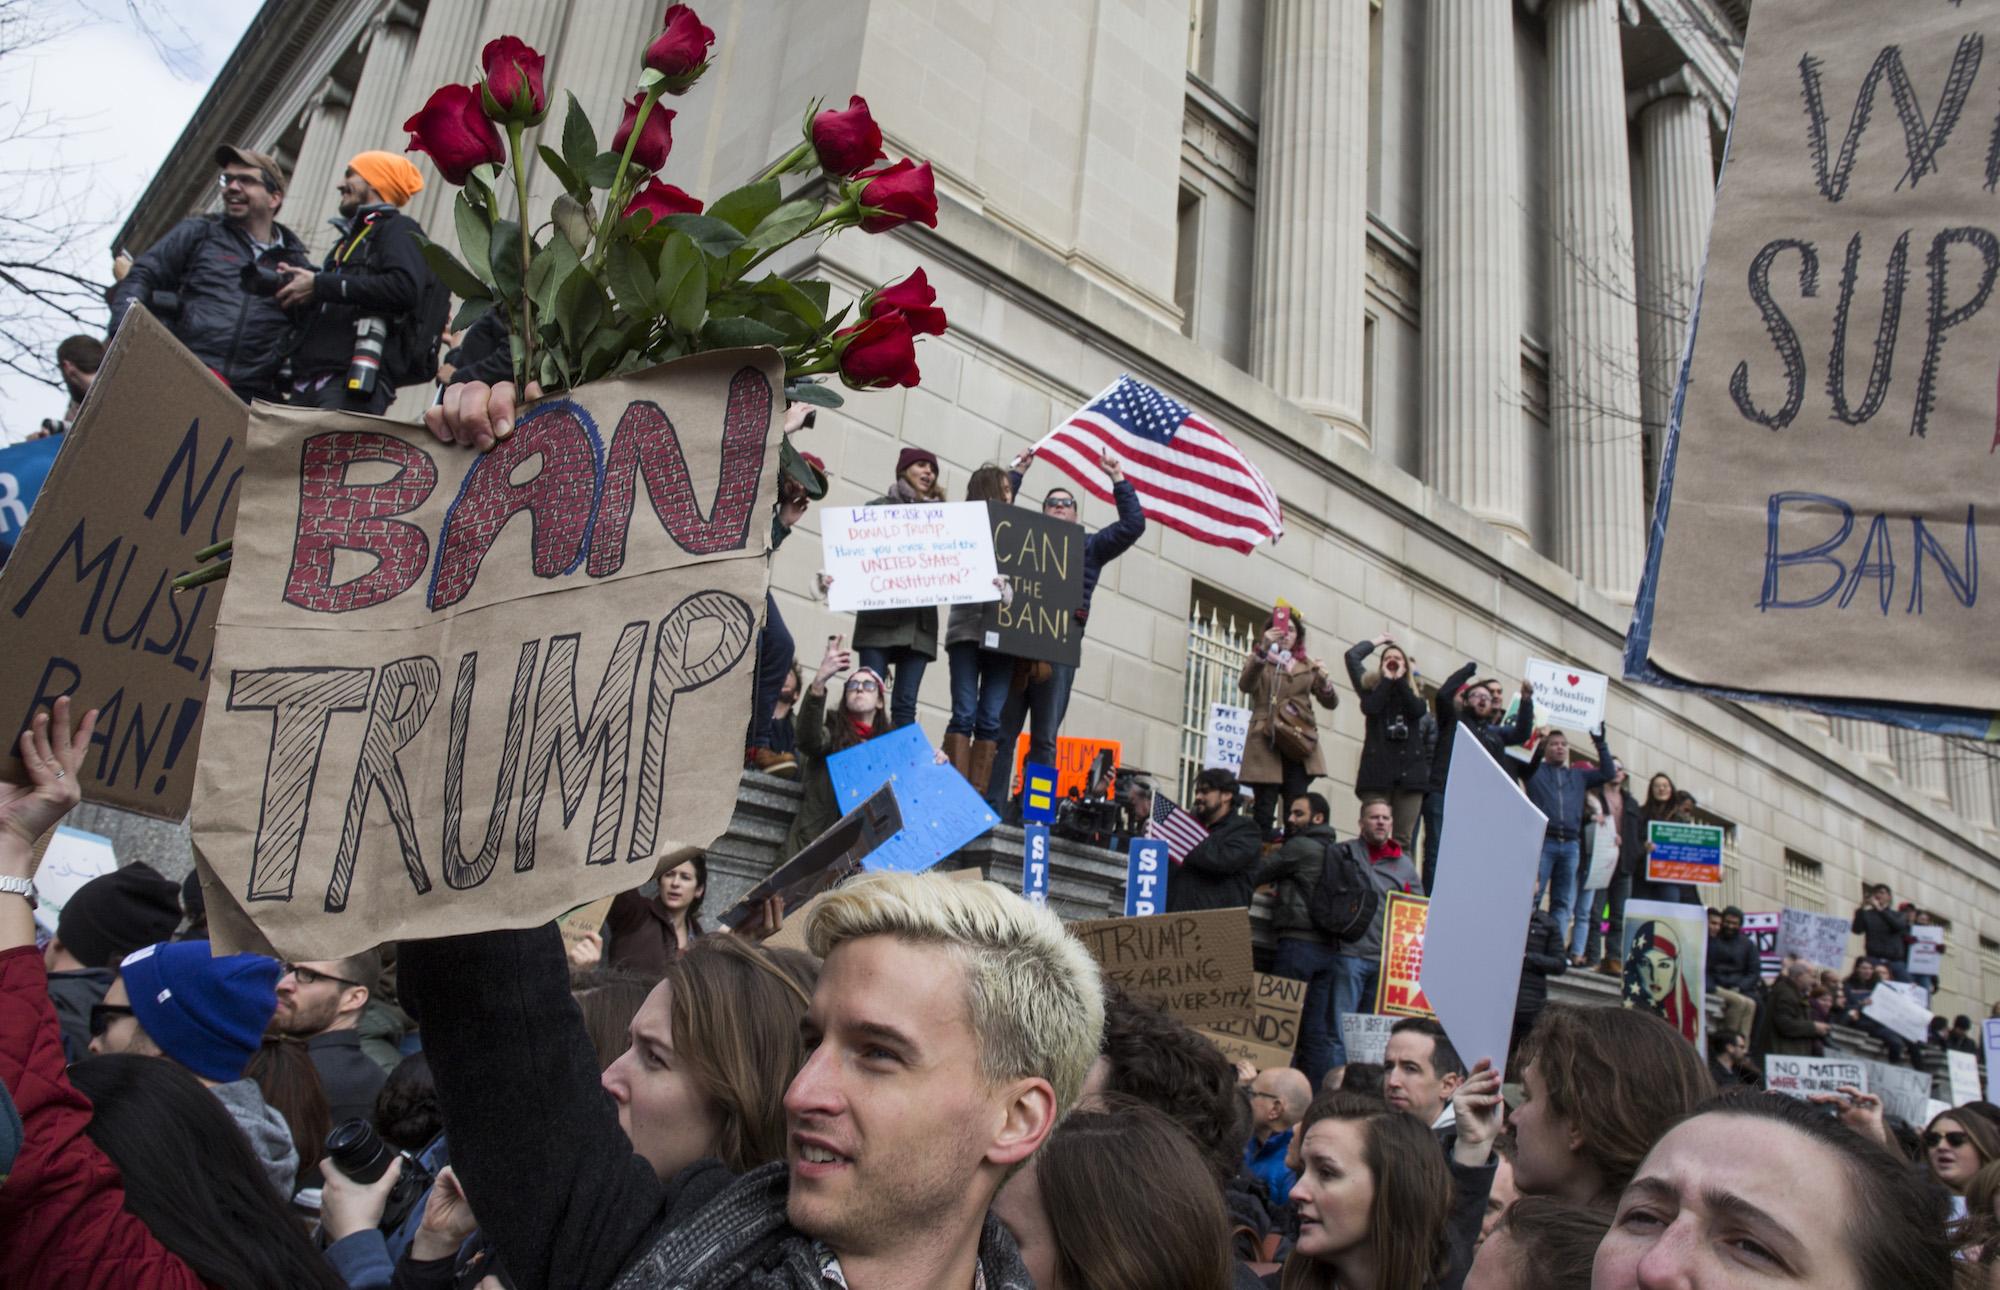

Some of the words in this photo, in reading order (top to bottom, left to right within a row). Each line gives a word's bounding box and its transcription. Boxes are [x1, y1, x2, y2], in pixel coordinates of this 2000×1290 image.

[1798, 31, 2000, 203] W
[281, 366, 774, 613] BAN
[993, 520, 1069, 581] CAN
[1755, 489, 1979, 616] BAN
[861, 556, 917, 574] UNITED
[11, 517, 216, 682] MUSL
[1013, 575, 1043, 599] THE
[998, 601, 1069, 644] BAN!
[1536, 696, 1588, 717] Neighbor
[1553, 685, 1595, 705] Muslim
[1216, 707, 1238, 721] THE
[226, 589, 755, 912] TRUMP
[1394, 903, 1428, 920] RE
[1257, 974, 1300, 1002] BAN
[1775, 1061, 1800, 1076] NO
[1808, 1063, 1861, 1079] MATTER
[1801, 1078, 1817, 1091] YOU
